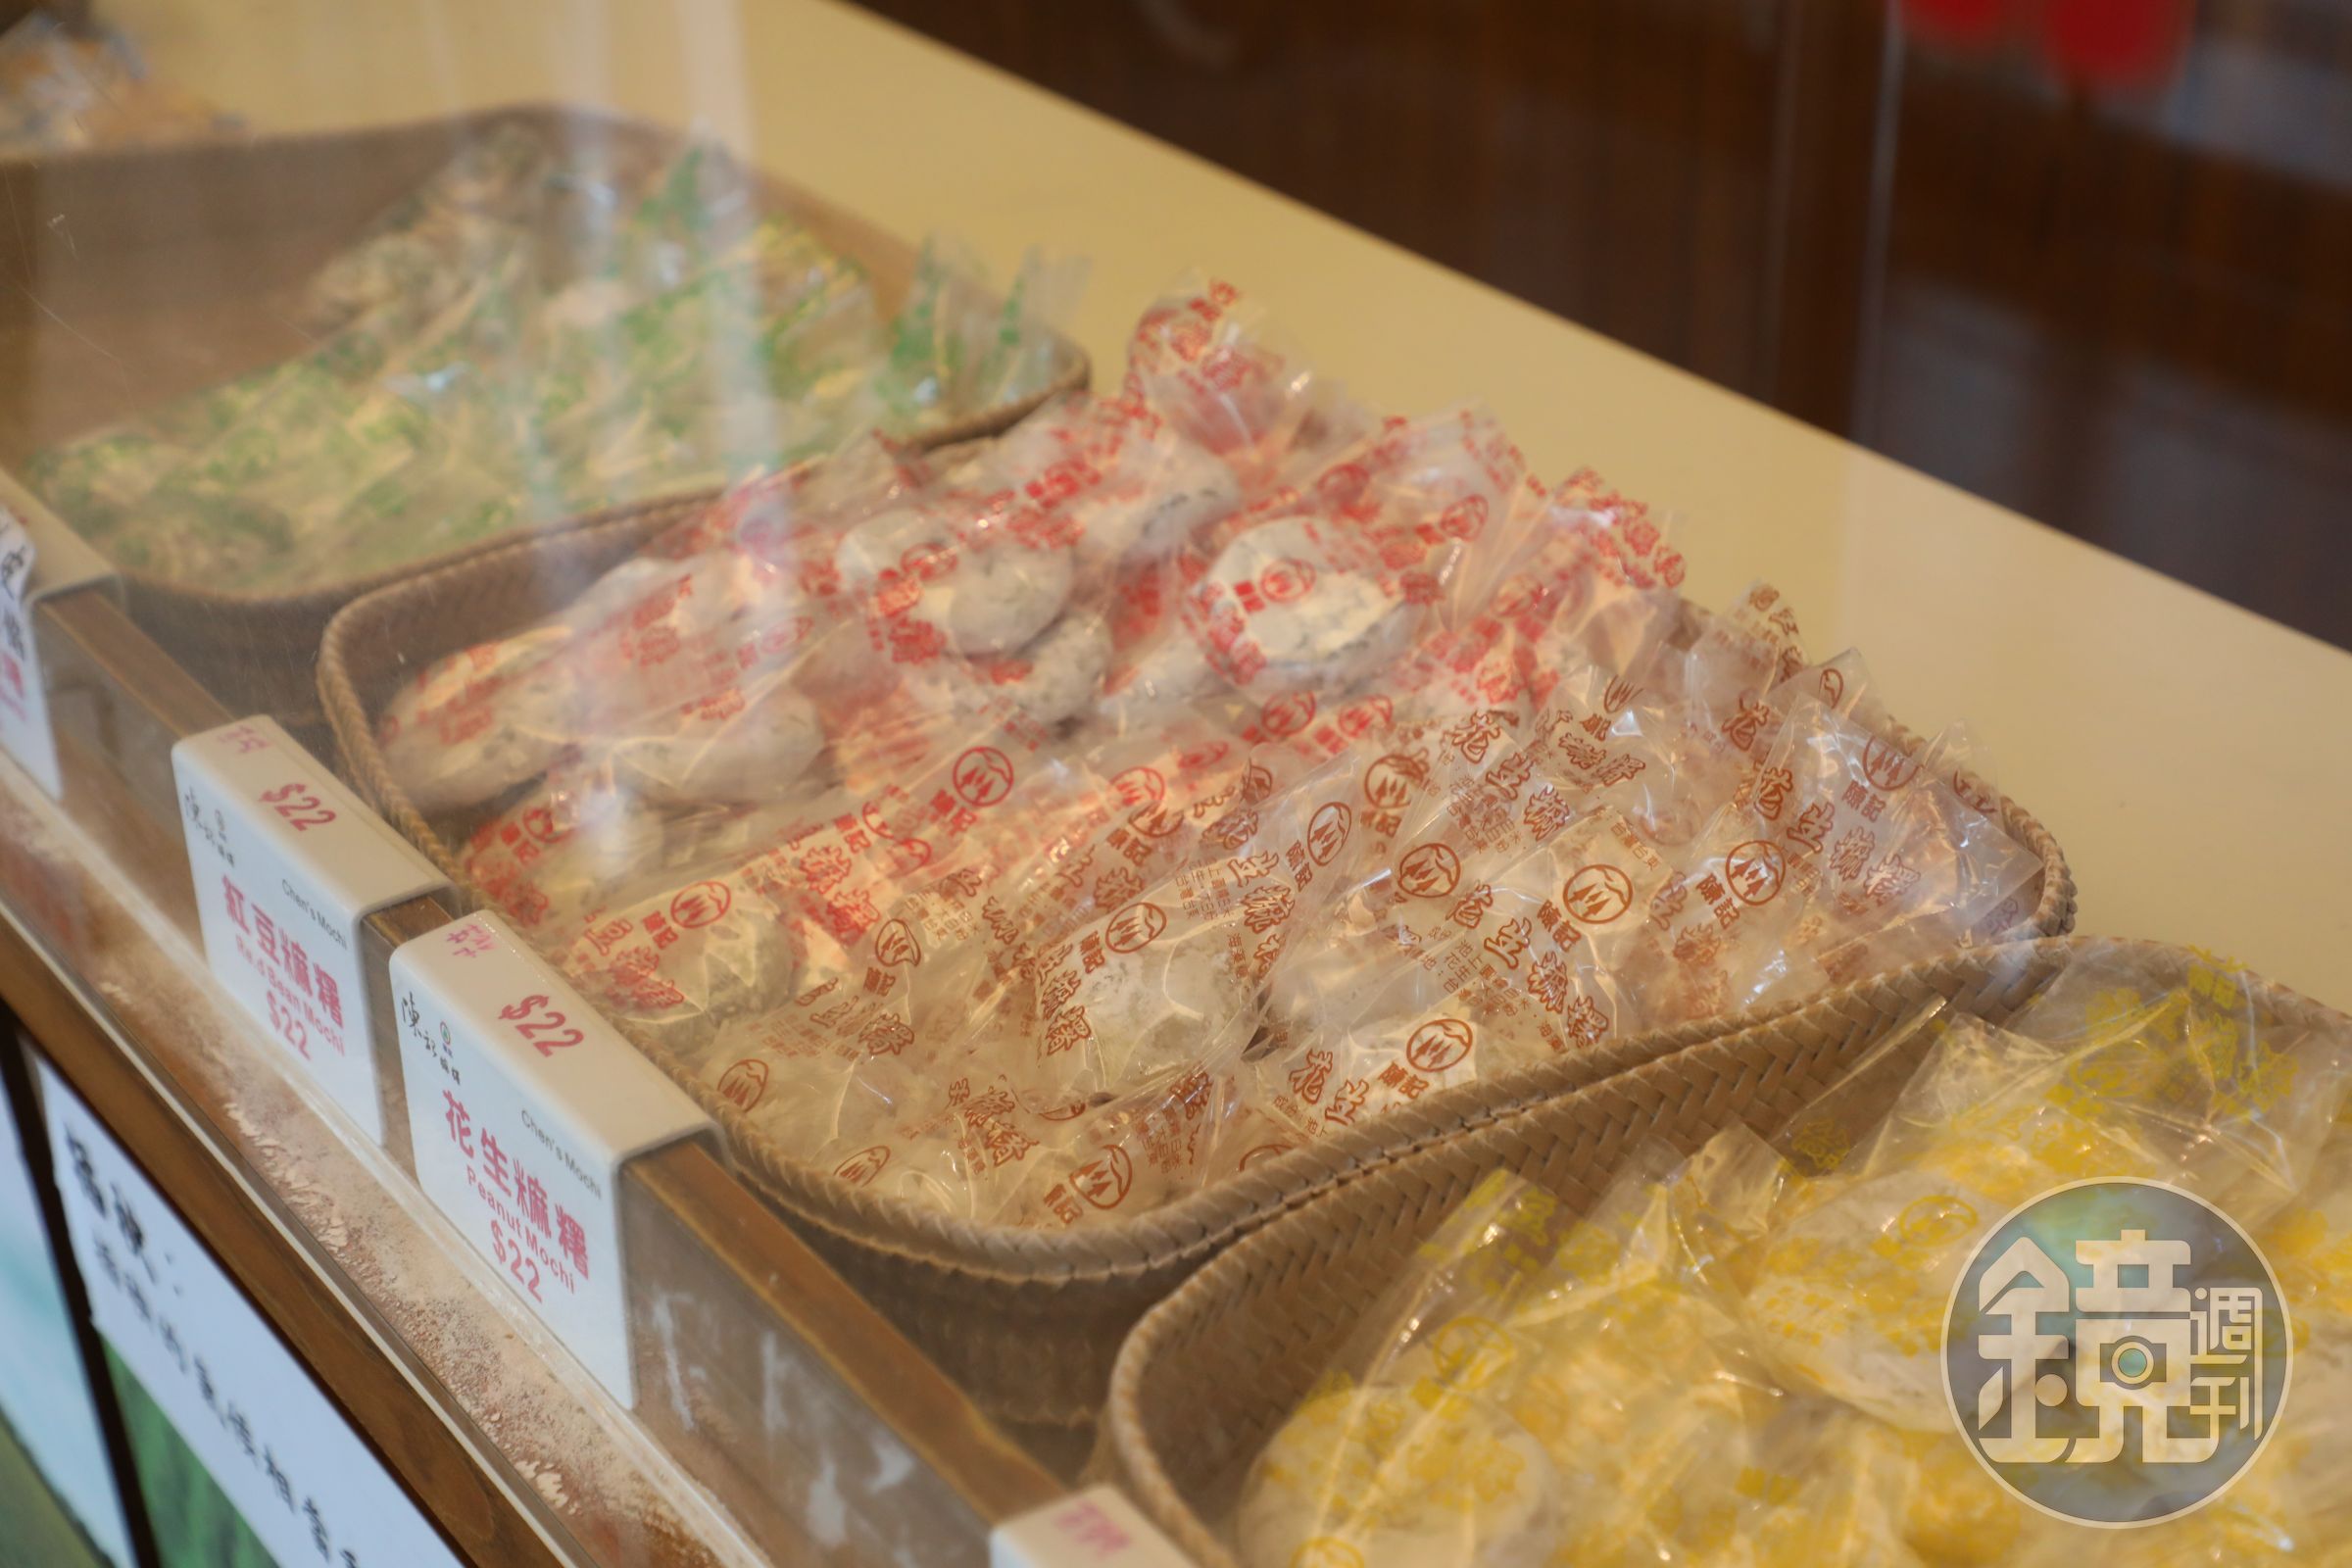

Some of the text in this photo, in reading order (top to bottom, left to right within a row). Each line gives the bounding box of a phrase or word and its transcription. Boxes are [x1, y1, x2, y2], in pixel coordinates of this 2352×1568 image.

[258, 782, 337, 832] $22
[281, 879, 348, 952] Chen's Mochi
[268, 967, 301, 1012] Bean
[303, 1002, 346, 1056] Mochi
[268, 991, 310, 1061] $22
[499, 994, 584, 1058] $22
[1378, 1060, 1430, 1100] 陳記
[521, 1107, 602, 1200] Chen's Mochi
[466, 1162, 575, 1295] Peanut Mochi
[492, 1217, 543, 1304] $22
